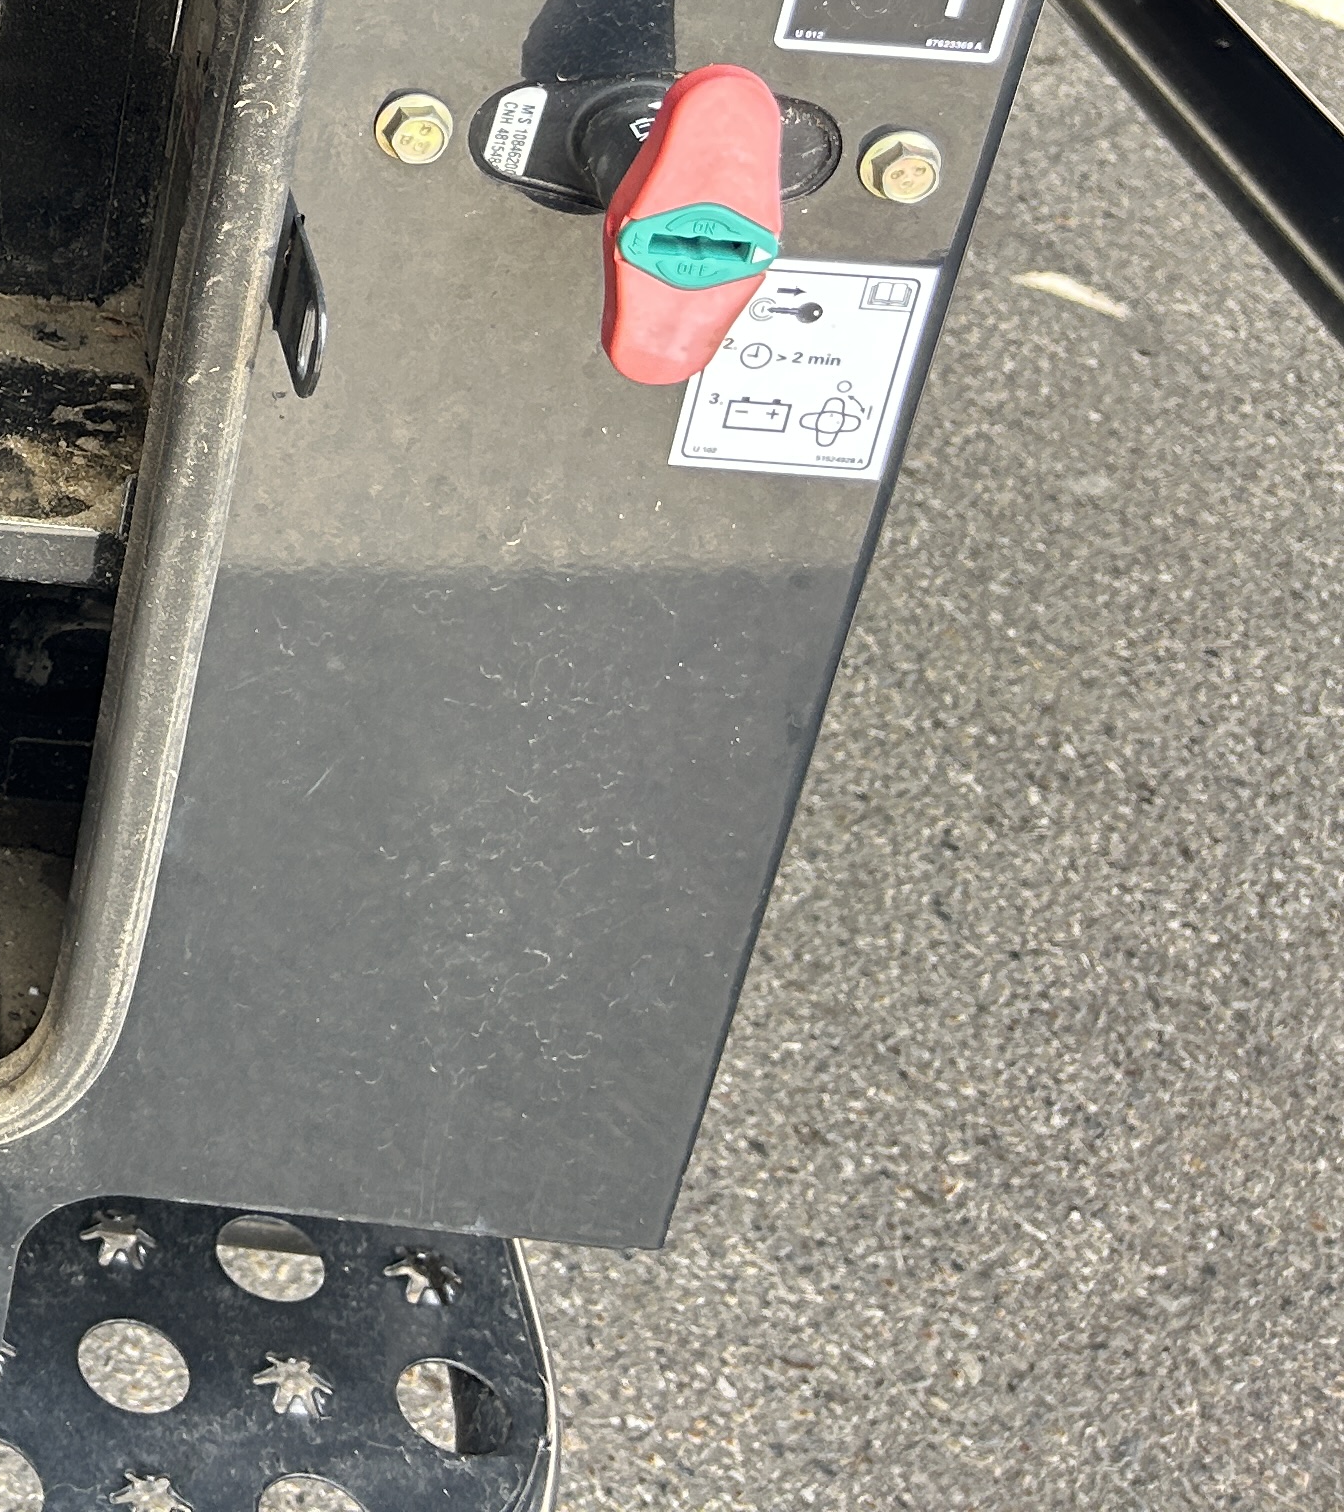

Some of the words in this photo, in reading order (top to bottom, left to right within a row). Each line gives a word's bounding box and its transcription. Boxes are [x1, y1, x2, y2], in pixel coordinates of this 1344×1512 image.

[500, 102, 518, 124] CNH
[693, 221, 717, 235] ON
[677, 262, 710, 277] OFF
[722, 338, 737, 350] 2.
[792, 352, 803, 363] 2
[808, 353, 841, 366] min
[709, 393, 723, 405] 3.
